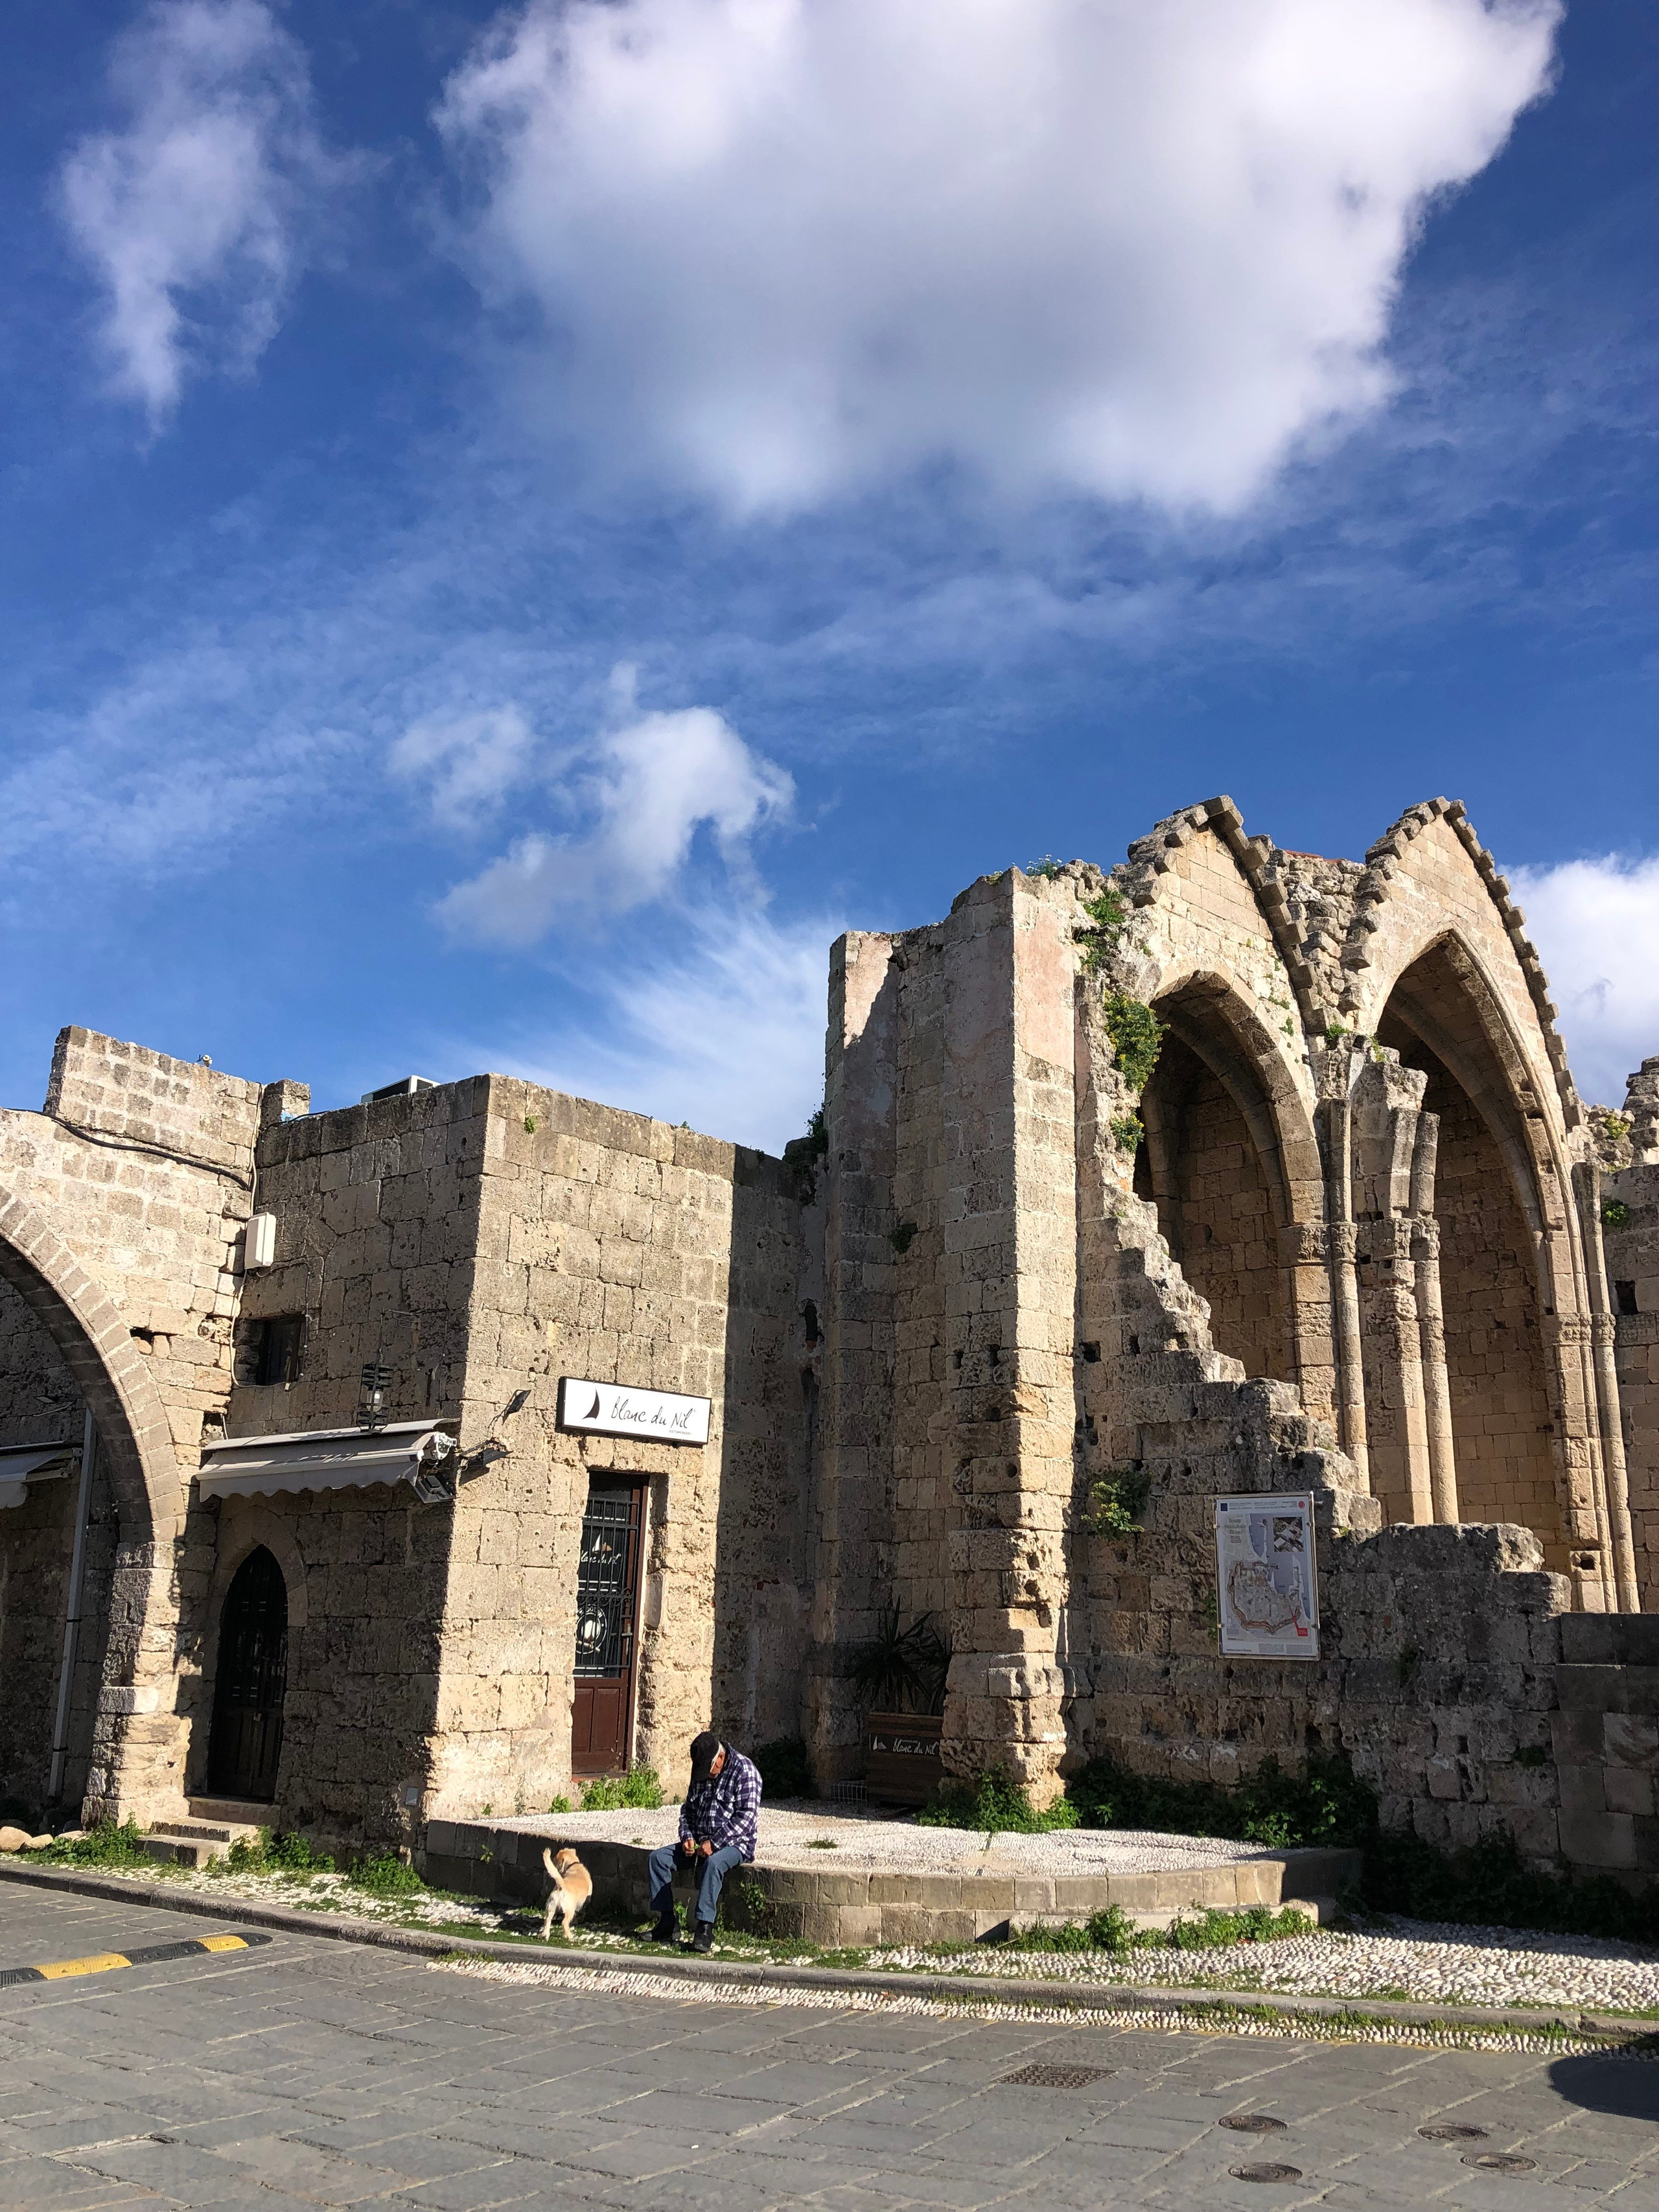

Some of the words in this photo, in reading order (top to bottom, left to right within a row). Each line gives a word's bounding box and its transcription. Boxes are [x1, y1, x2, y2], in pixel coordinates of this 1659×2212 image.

[611, 1396, 647, 1423] Blanc
[651, 1406, 667, 1425] du
[671, 1408, 693, 1429] Nil
[914, 1741, 923, 1754] du
[925, 1741, 937, 1755] Nil
